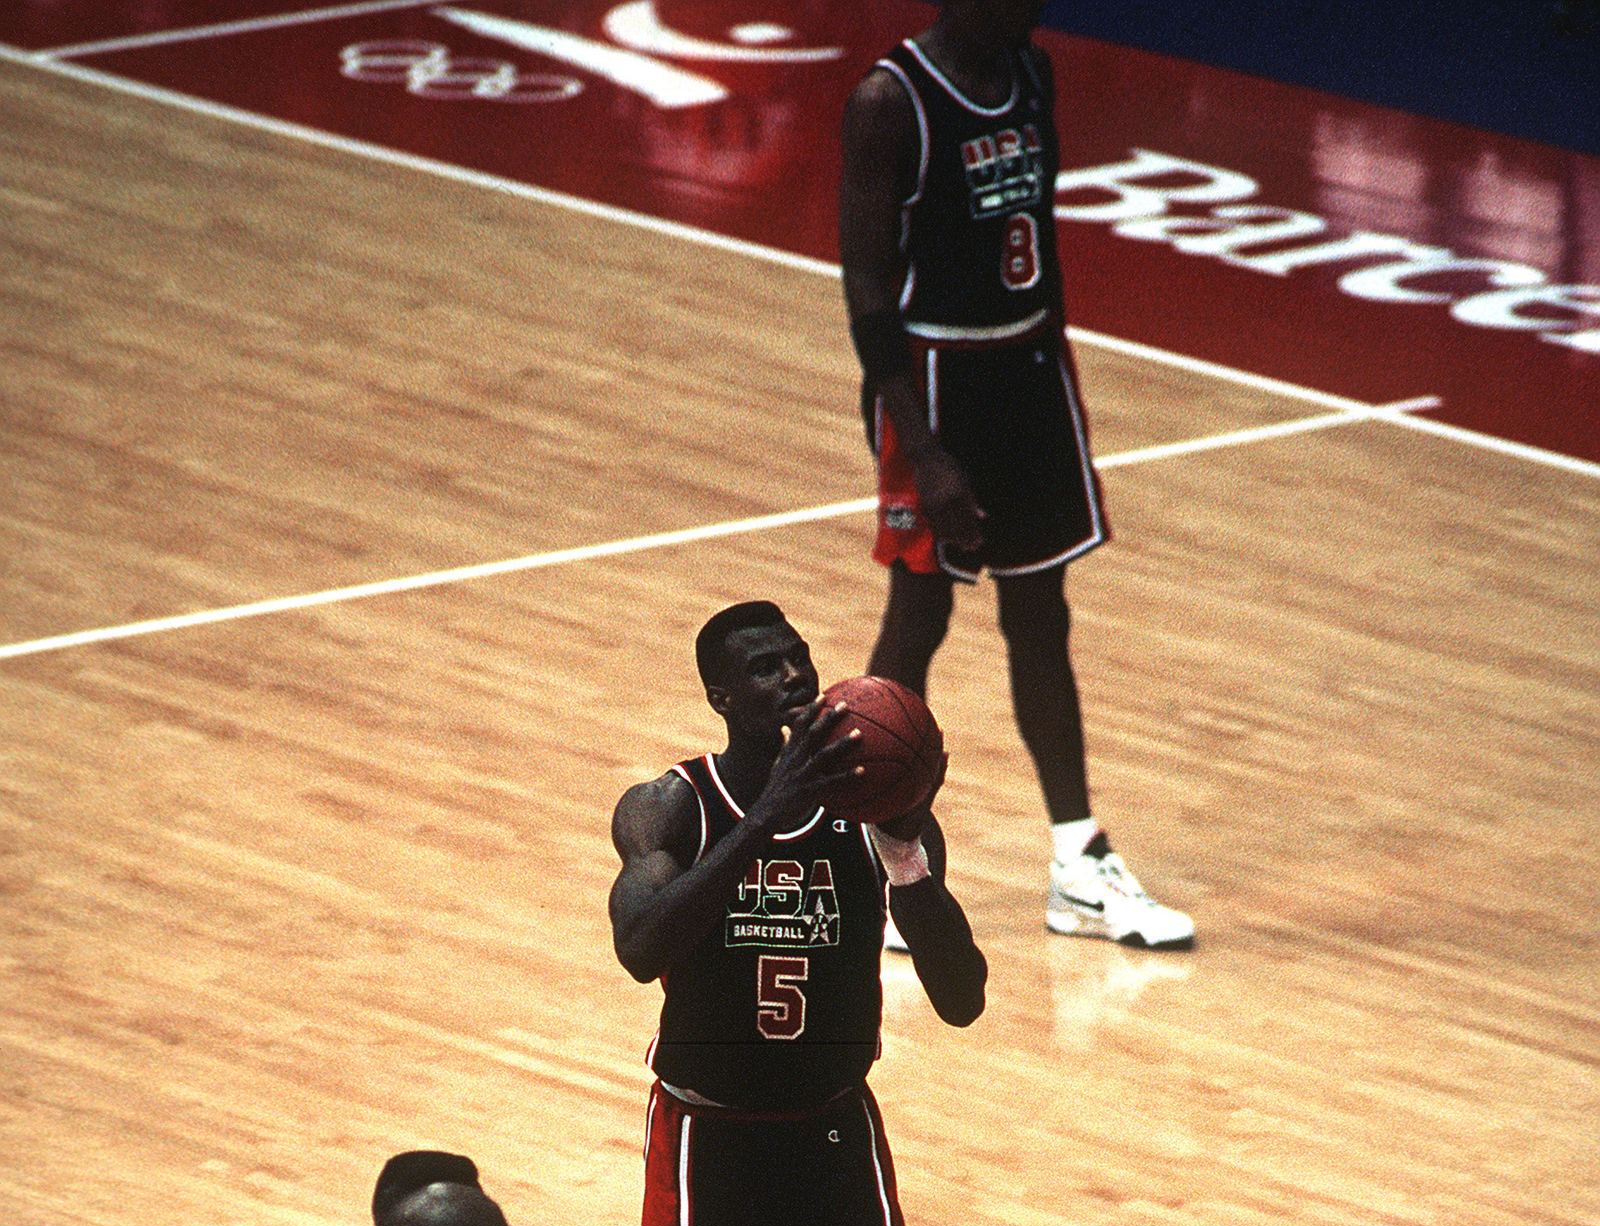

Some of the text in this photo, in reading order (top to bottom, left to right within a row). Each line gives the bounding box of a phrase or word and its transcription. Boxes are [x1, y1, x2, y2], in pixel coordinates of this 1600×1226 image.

[1003, 212, 1042, 291] 8
[733, 924, 805, 940] BASKETBALL
[757, 955, 808, 1040] 5
